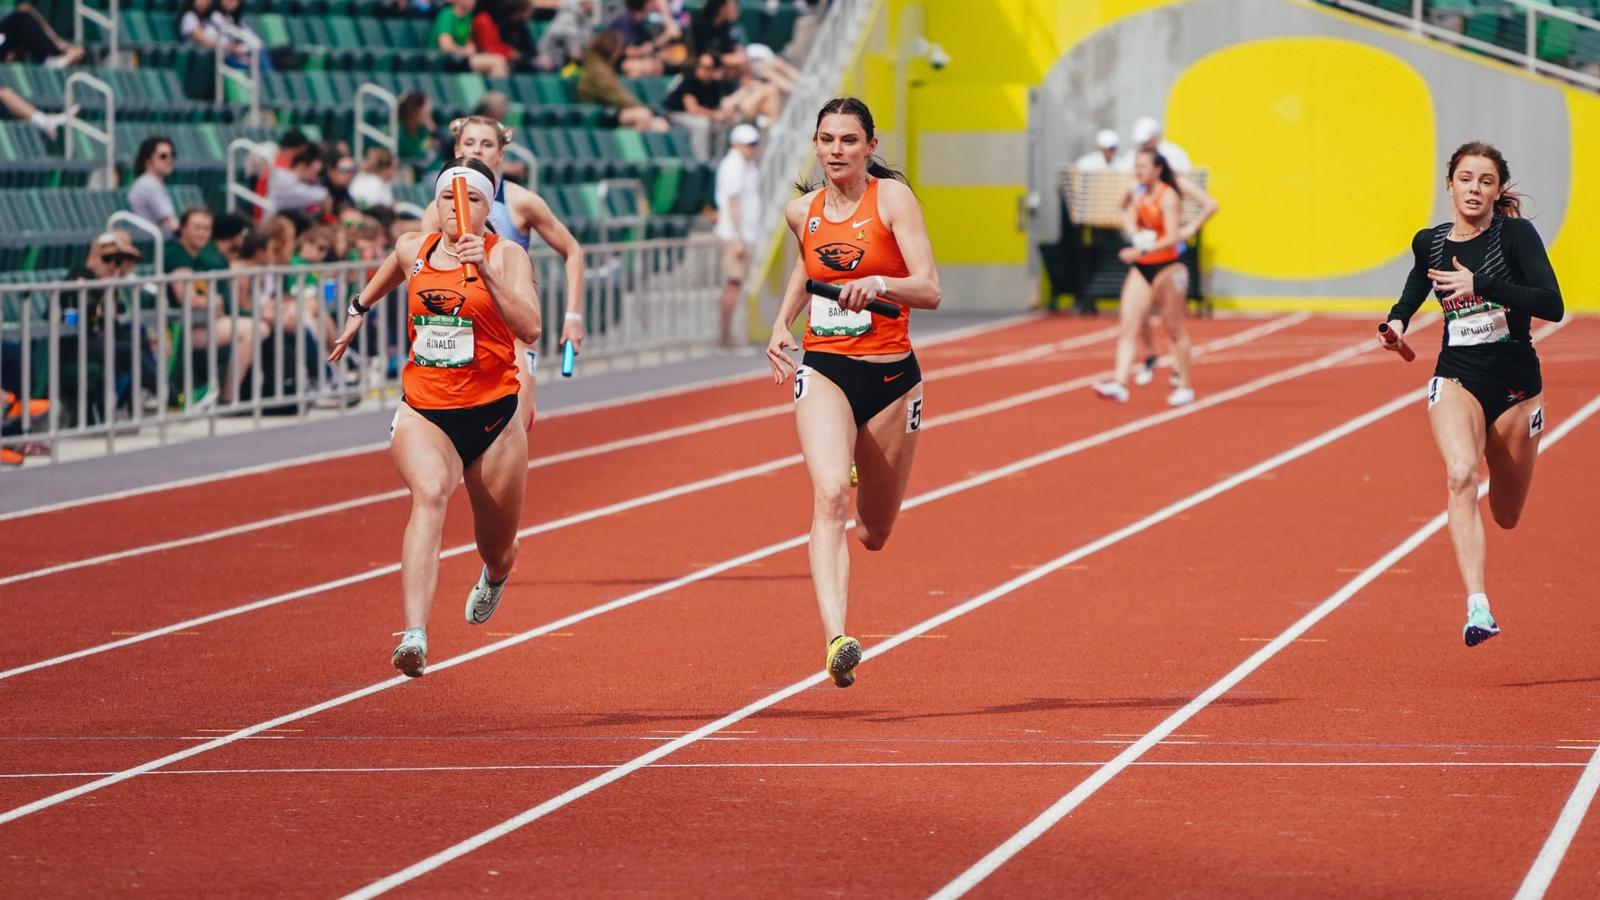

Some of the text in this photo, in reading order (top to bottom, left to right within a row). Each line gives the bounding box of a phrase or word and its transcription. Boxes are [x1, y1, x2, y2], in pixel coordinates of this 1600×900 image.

[426, 338, 456, 349] RINALDI
[911, 399, 921, 431] 5
[1531, 408, 1543, 430] 4
